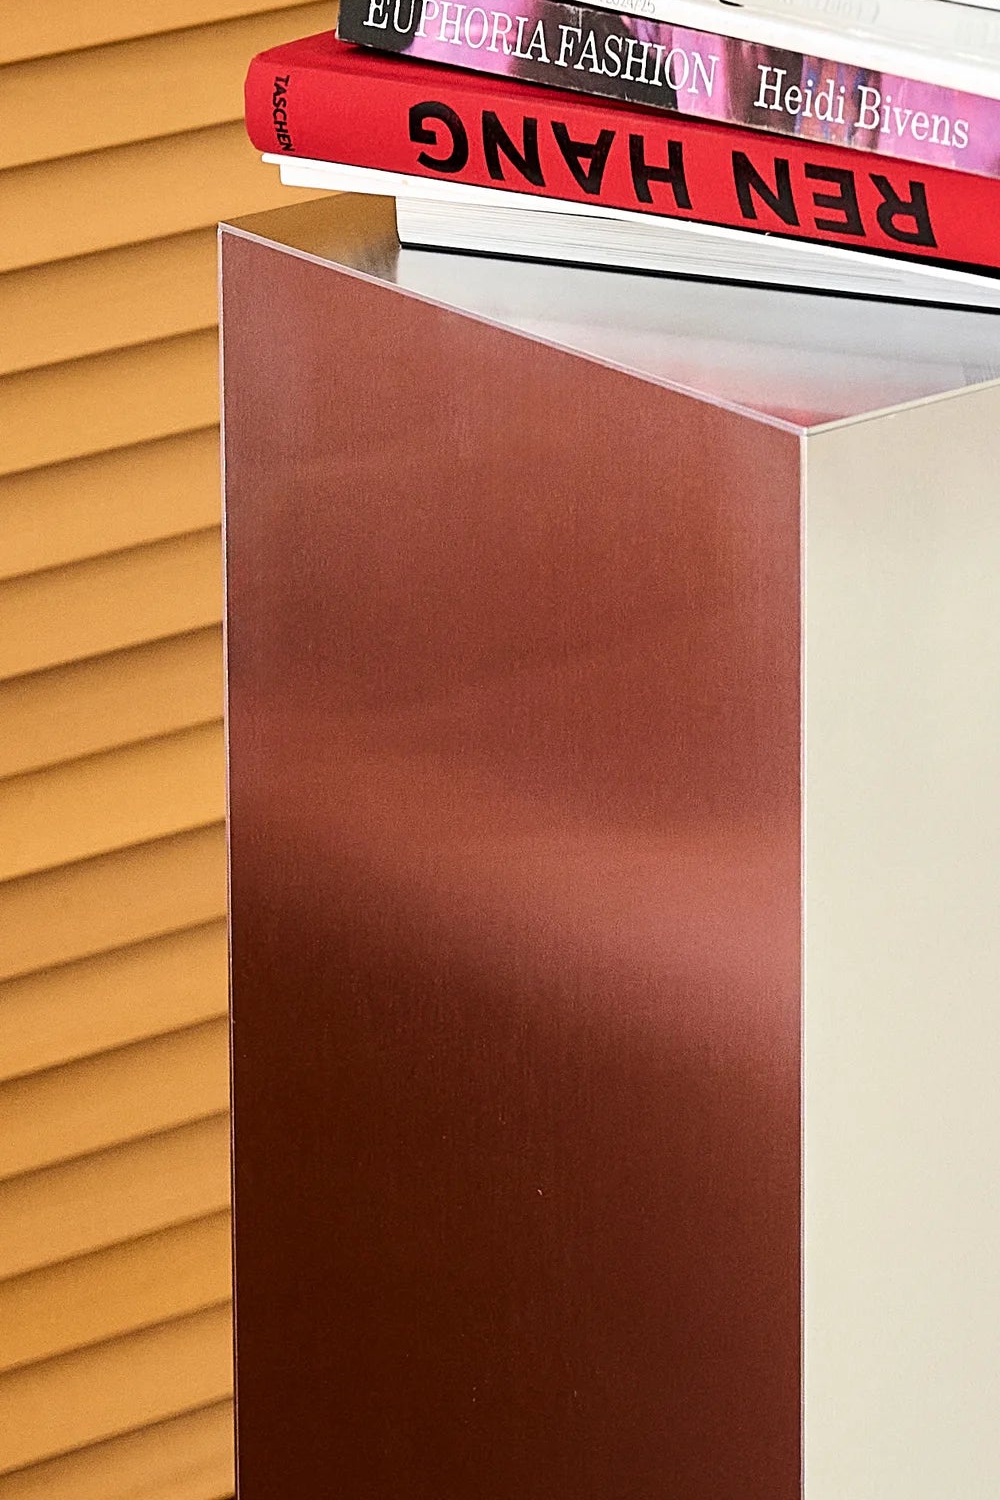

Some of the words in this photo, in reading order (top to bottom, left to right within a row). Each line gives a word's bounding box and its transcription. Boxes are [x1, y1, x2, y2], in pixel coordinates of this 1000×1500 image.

[554, 24, 721, 98] FASHION
[272, 74, 296, 152] TASCHEN
[753, 64, 847, 125] Heidi
[853, 84, 970, 150] Bivens
[408, 100, 693, 210] HANG
[731, 149, 938, 248] REN
